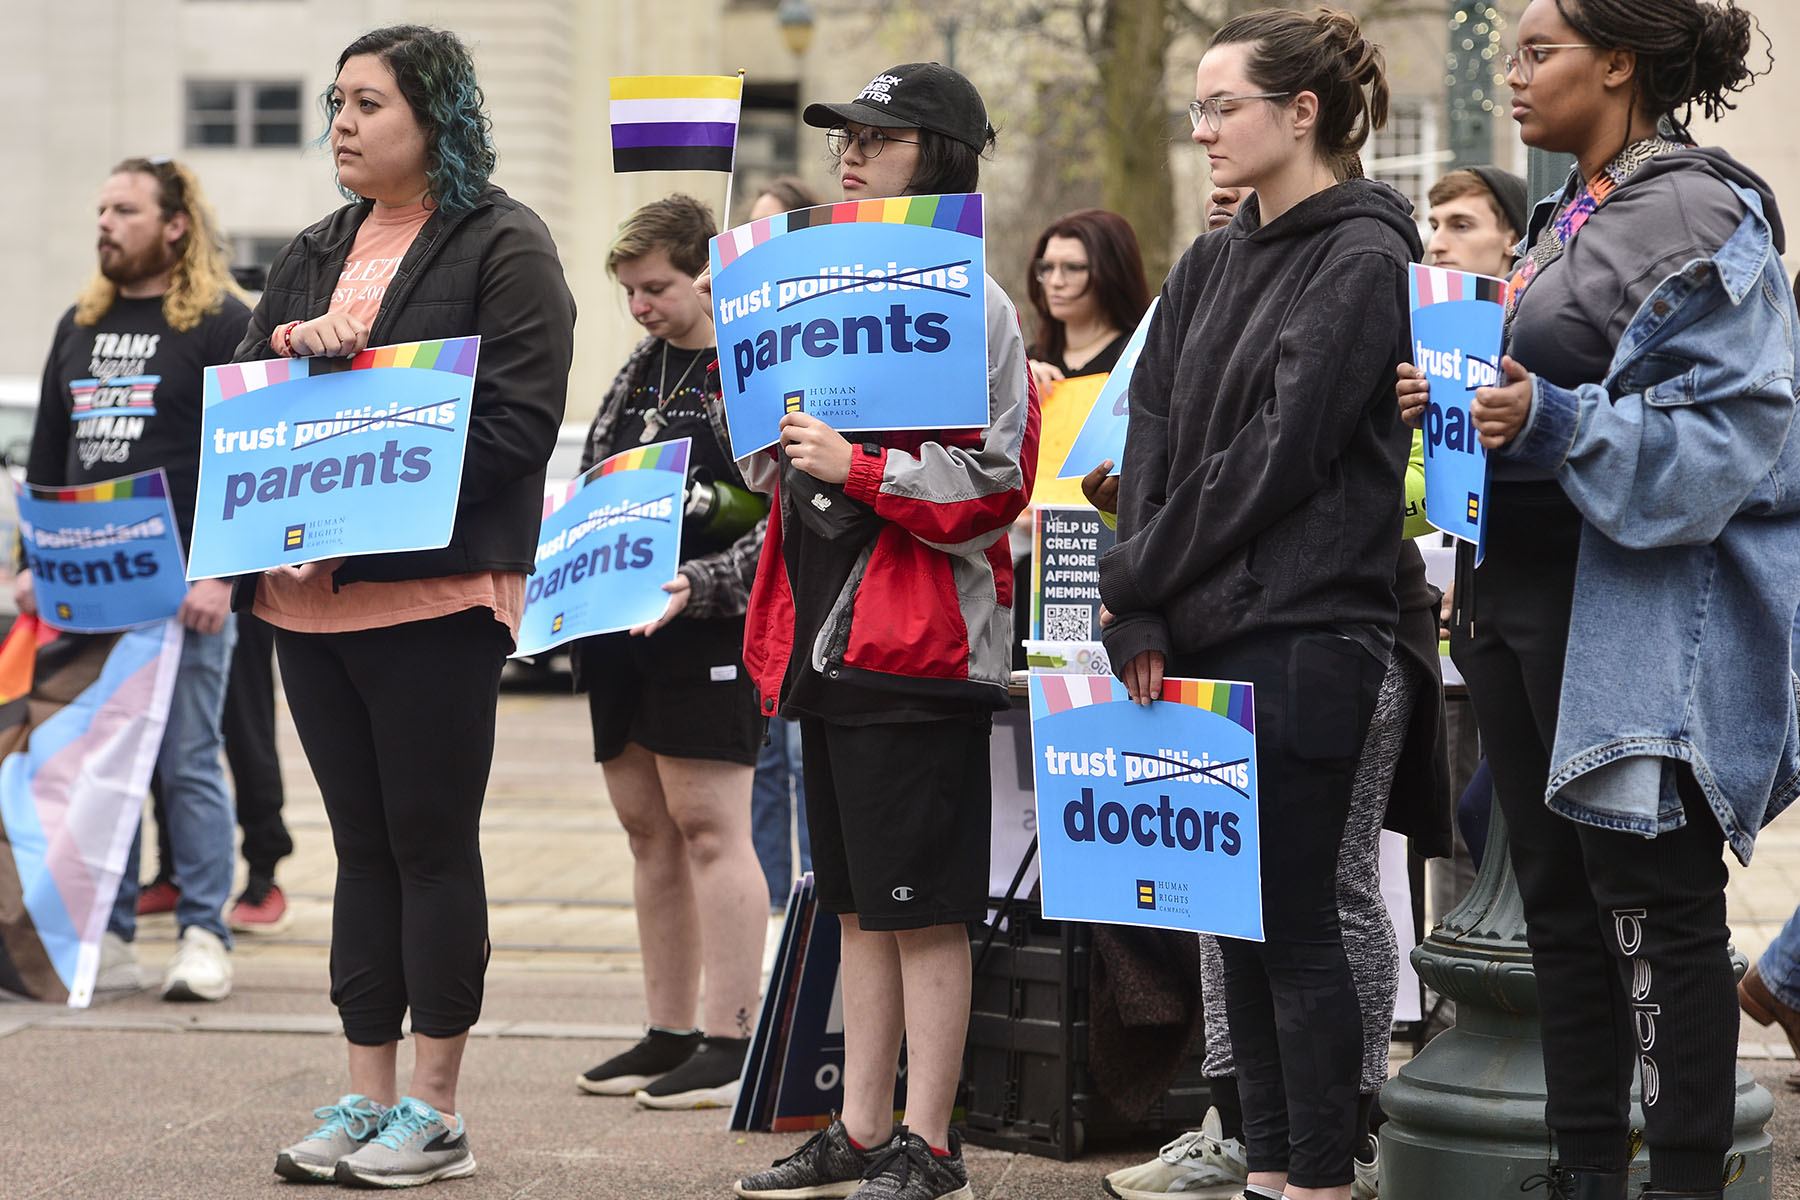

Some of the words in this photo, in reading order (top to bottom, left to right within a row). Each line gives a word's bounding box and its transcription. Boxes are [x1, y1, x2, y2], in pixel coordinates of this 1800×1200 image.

[719, 280, 771, 325] trust
[779, 261, 968, 308] politicians
[91, 332, 161, 359] TRANS
[734, 304, 951, 394] parents
[88, 357, 146, 386] rights
[1416, 340, 1462, 381] trust
[90, 386, 132, 408] are
[810, 386, 856, 396] HUMAN
[810, 398, 857, 407] RIGHTS
[75, 415, 145, 440] HUMAN
[213, 421, 288, 454] trust
[293, 402, 456, 449] politicians
[1427, 402, 1486, 459] par
[222, 439, 433, 521] parents
[1046, 521, 1080, 534] HELP
[1081, 521, 1100, 534] US
[1045, 537, 1097, 550] CREATE
[523, 532, 654, 615] parents
[1045, 553, 1056, 566] A
[1058, 554, 1096, 567] MORE
[1045, 745, 1117, 777] trust
[1125, 748, 1249, 789] politicians
[1063, 788, 1242, 857] doctors
[1158, 880, 1189, 892] HUMAN
[1159, 893, 1189, 905] RIGHTS
